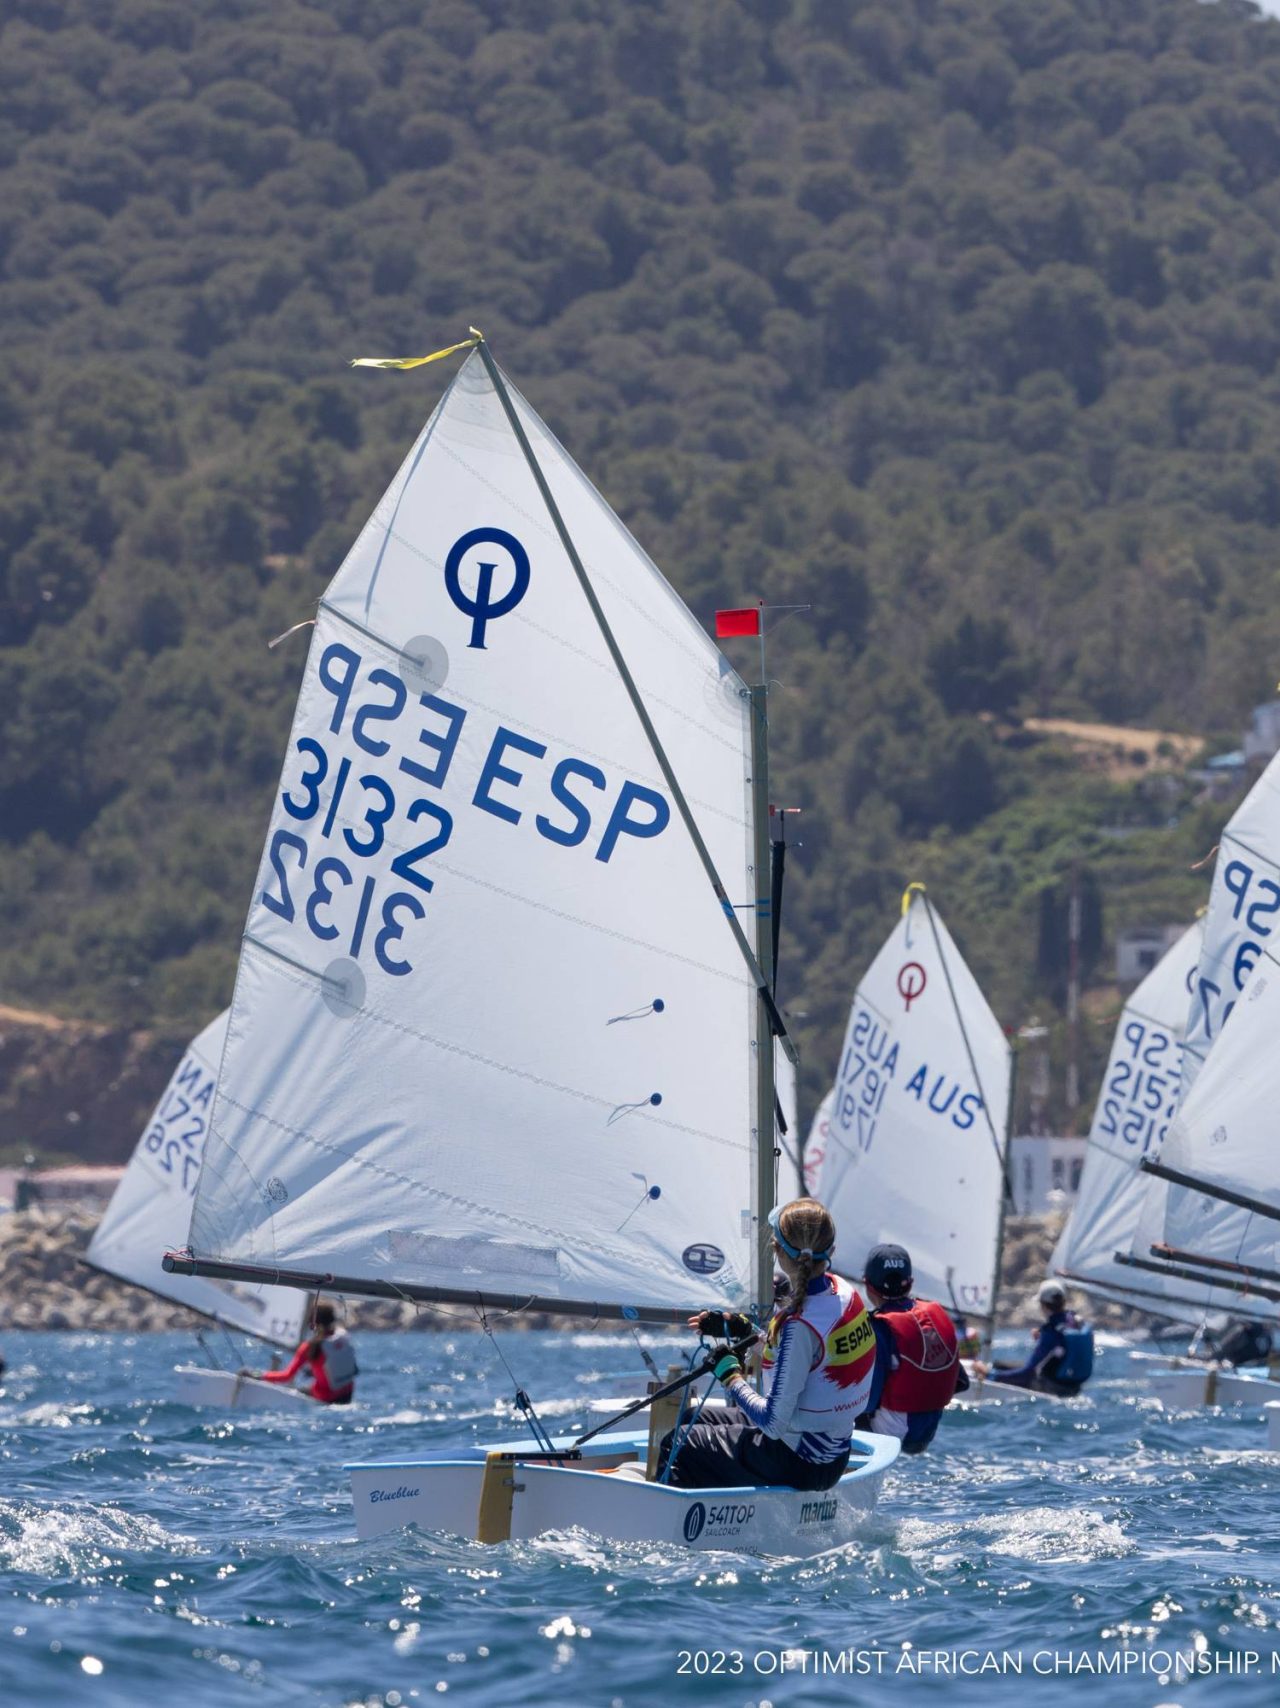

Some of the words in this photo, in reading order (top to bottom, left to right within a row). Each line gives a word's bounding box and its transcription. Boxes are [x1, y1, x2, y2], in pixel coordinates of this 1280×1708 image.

[283, 737, 453, 893] 3132
[471, 725, 670, 863] ESP
[905, 1064, 983, 1129] AUS
[884, 1259, 905, 1269] AUS
[370, 1486, 421, 1503] Blueblue
